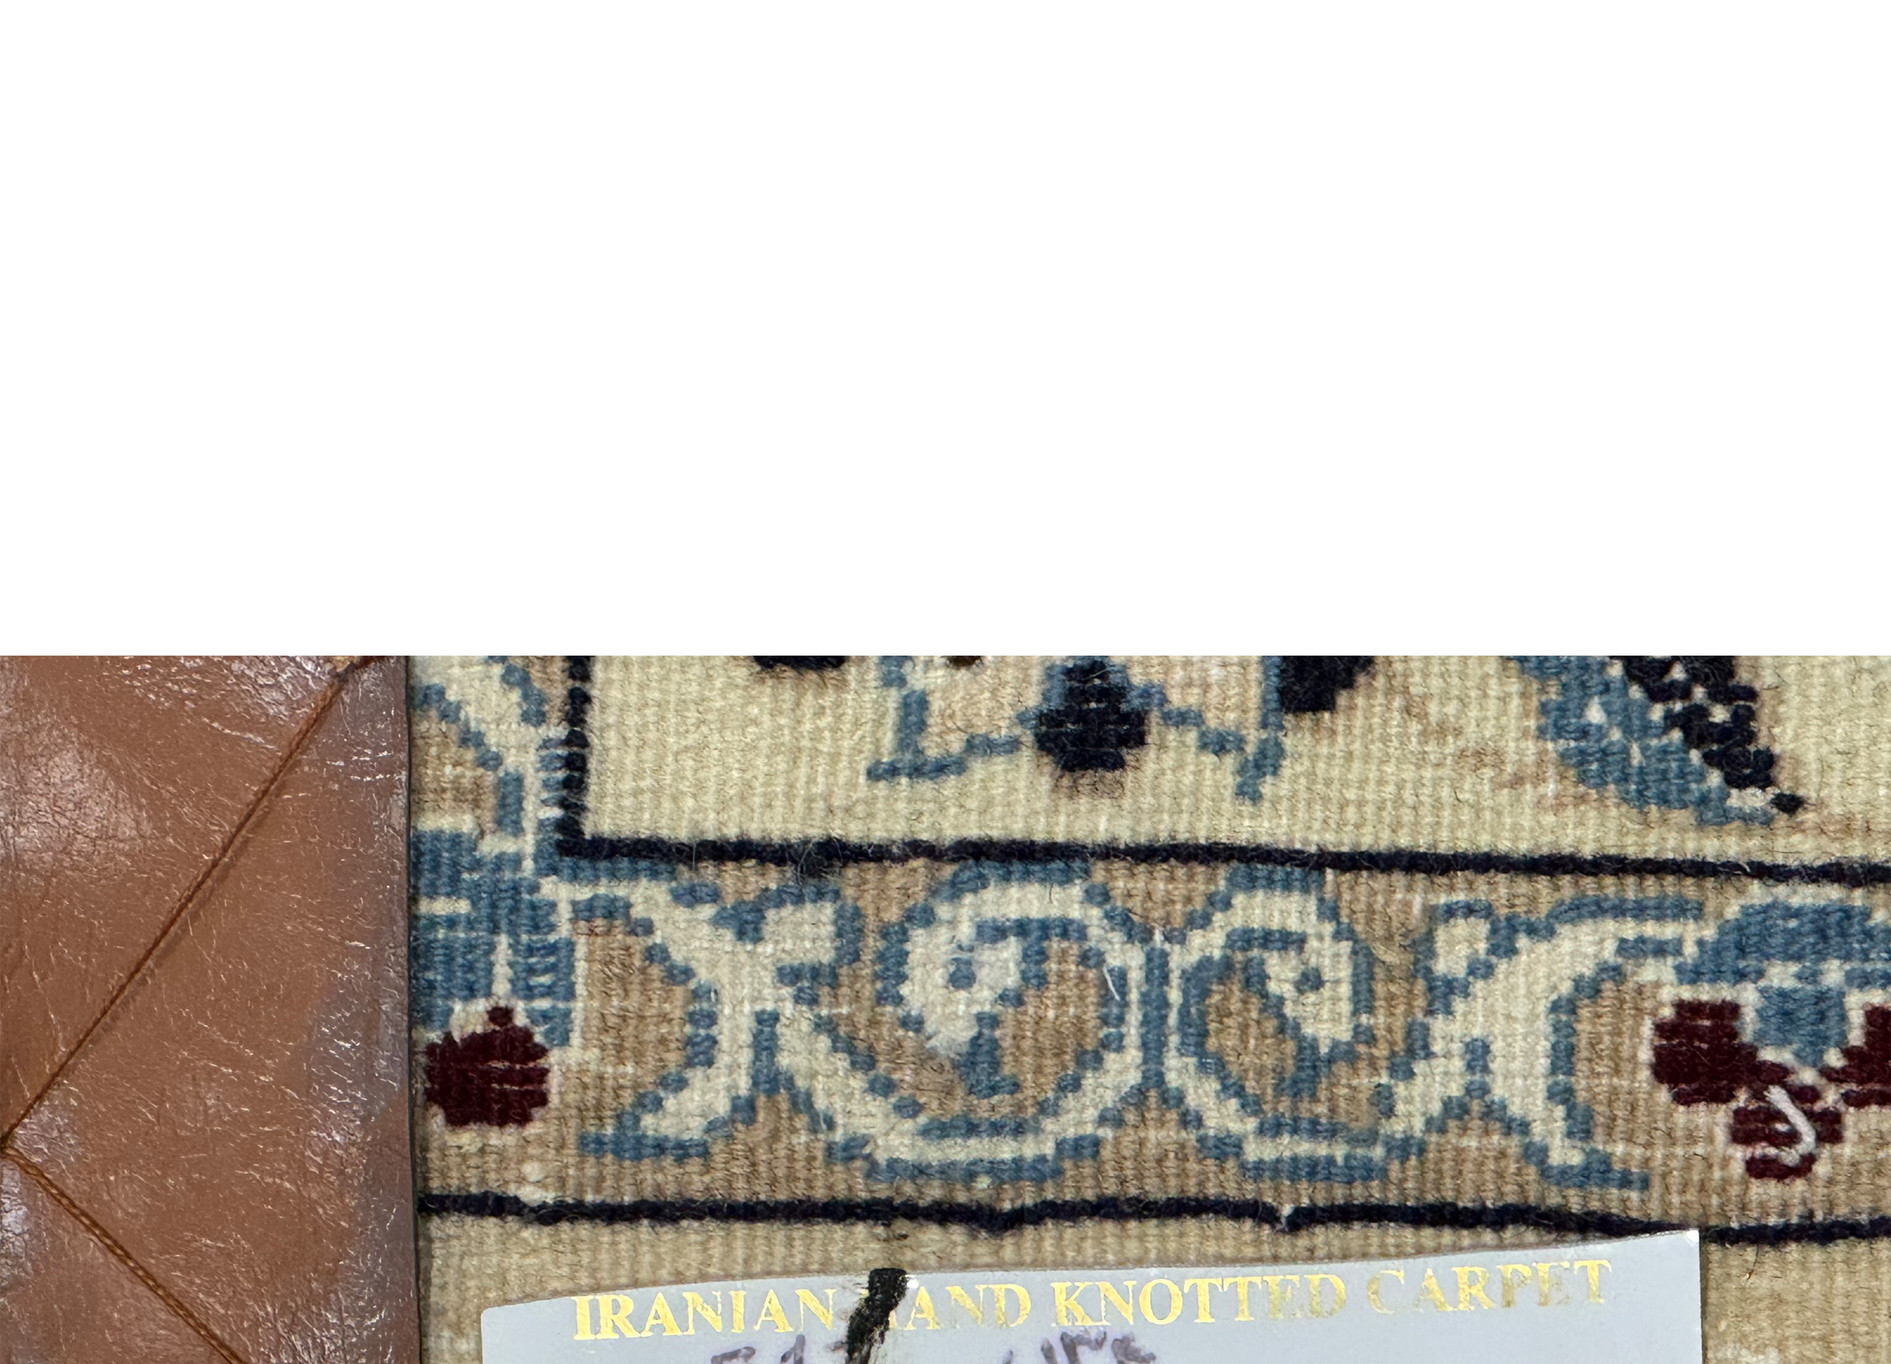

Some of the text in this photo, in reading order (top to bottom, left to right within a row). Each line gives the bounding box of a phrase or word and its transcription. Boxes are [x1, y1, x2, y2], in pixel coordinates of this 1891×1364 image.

[572, 1260, 1612, 1341] IRANIAN AND KNOTTED CARPET
